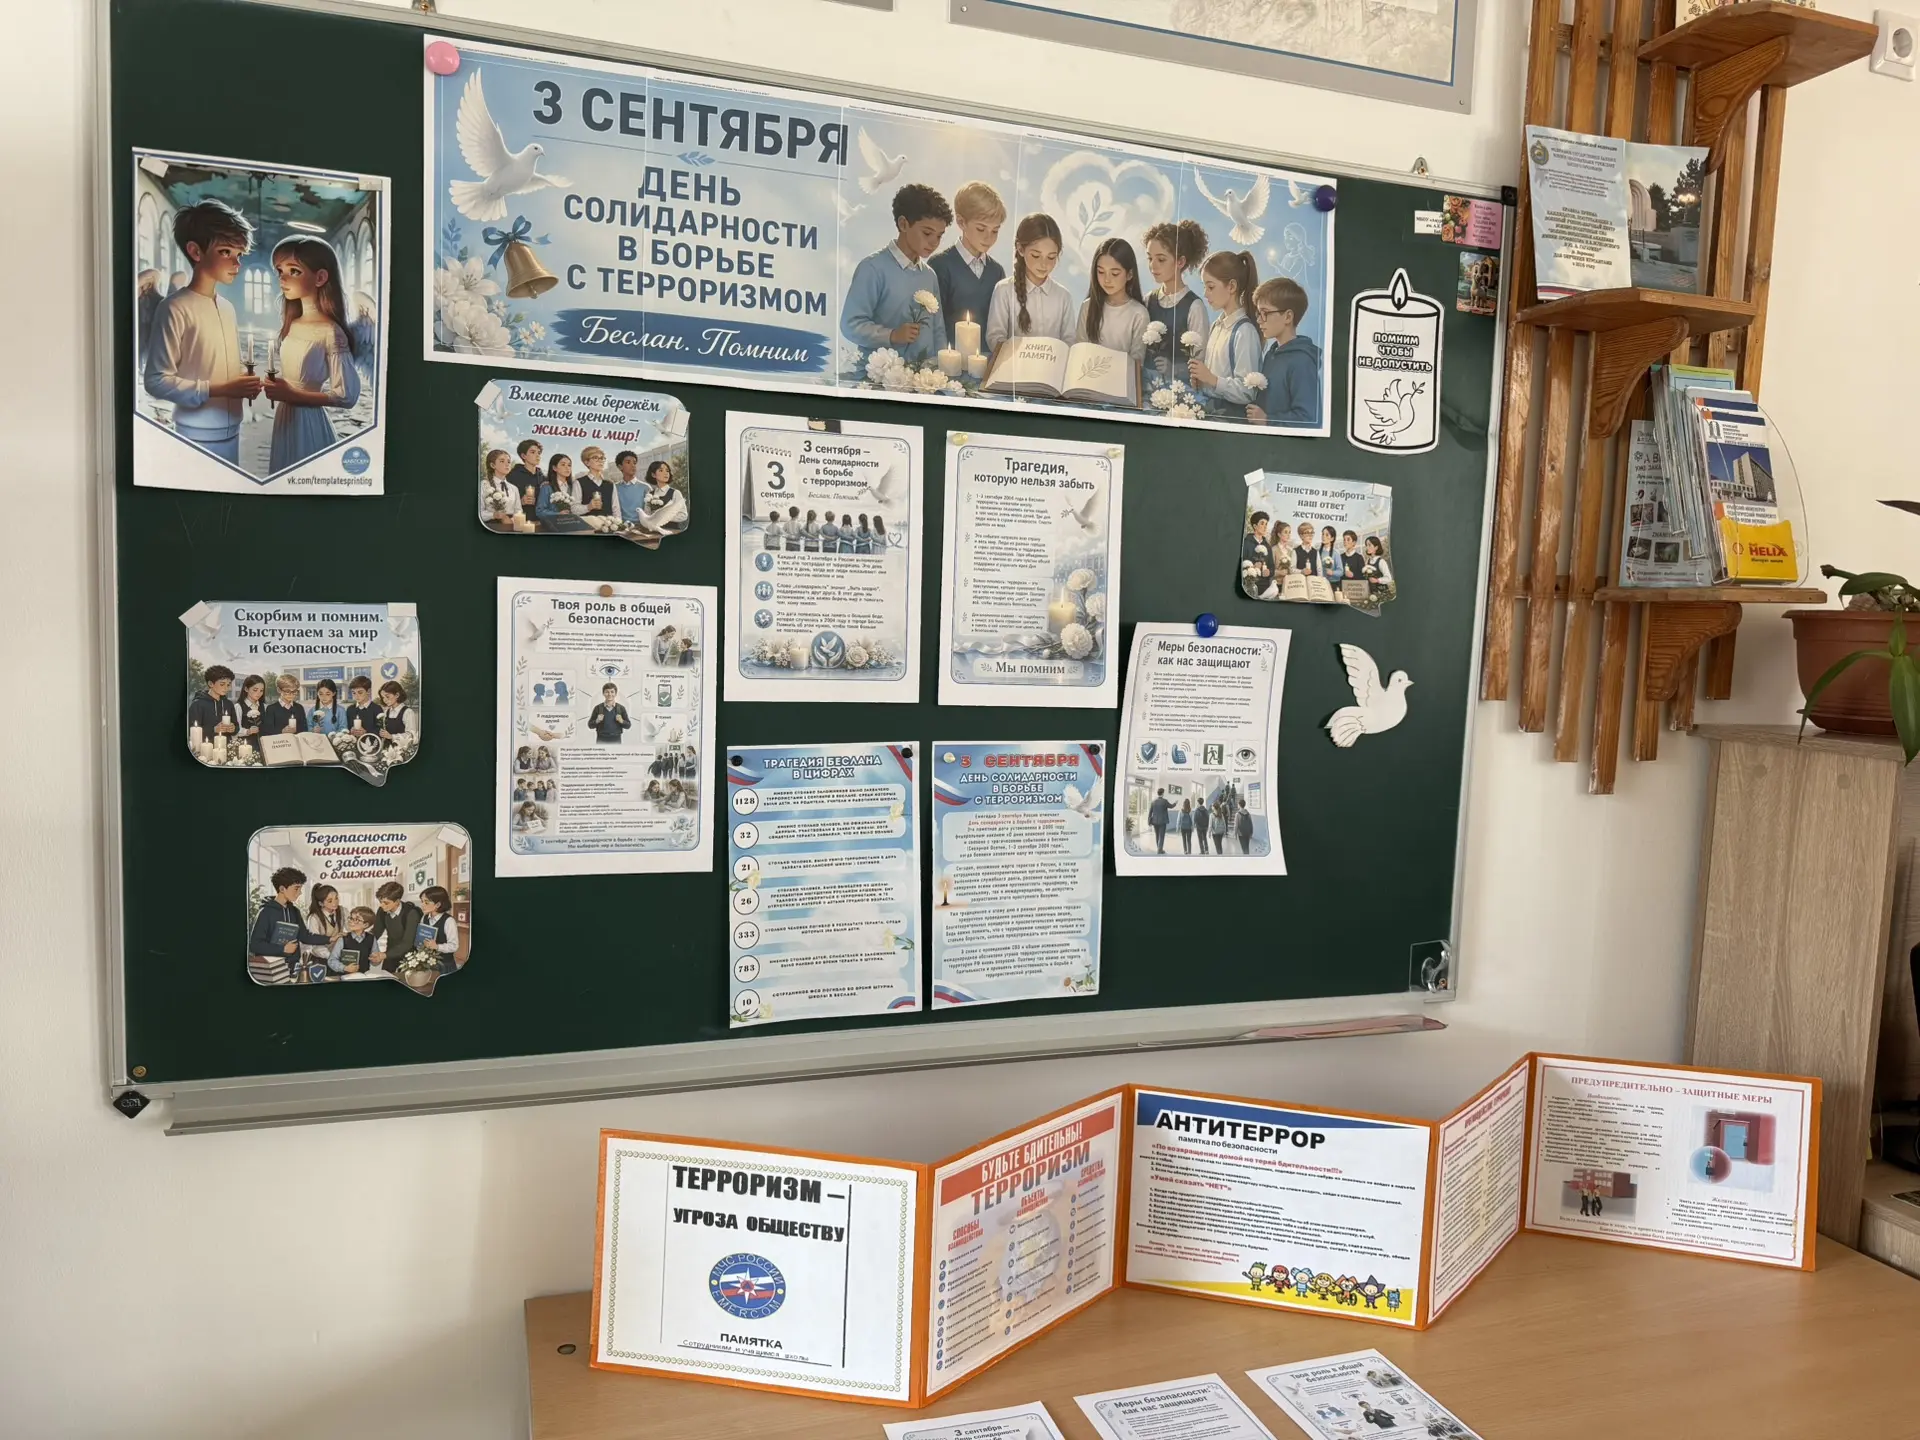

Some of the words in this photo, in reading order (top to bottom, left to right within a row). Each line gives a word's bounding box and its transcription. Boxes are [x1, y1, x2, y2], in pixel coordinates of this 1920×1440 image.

[533, 79, 563, 126] 3
[582, 87, 849, 168] СЕНТЯБРЯ
[637, 165, 741, 207] ДЕНЬ
[564, 193, 820, 252] СОЛИДАРНОСТИ
[619, 235, 637, 262] В
[651, 239, 775, 280] БОРЬБЕ
[567, 263, 587, 290] С
[596, 266, 828, 317] ТЕРРОРИЗМОМ
[579, 315, 690, 351] Беслан.
[698, 328, 810, 363] Помним
[1373, 333, 1419, 346] ПОМНИМ
[1025, 343, 1053, 353] КНИГА
[1378, 345, 1414, 358] ЧТОБЫ
[1019, 351, 1057, 362] ПАМЯТИ
[1358, 356, 1373, 368] НЕ
[1373, 358, 1433, 371] ДОПУСТИТЬ
[508, 385, 570, 405] Вместе
[573, 395, 599, 407] мы
[601, 394, 661, 413] бережём
[528, 407, 573, 422] самое
[577, 411, 626, 427] ценное
[531, 422, 587, 440] жизнь
[592, 427, 607, 438] и
[604, 430, 640, 446] мир!
[804, 441, 812, 453] 3
[815, 446, 861, 460] сентября
[799, 455, 820, 465] День
[822, 458, 879, 470] солидарности
[1004, 457, 1069, 477] Трагедия,
[767, 461, 786, 490] 3
[823, 466, 853, 478] борьбе
[287, 476, 373, 486] vk.com/templatesprinting
[810, 478, 867, 489] терроризмом
[974, 474, 1018, 487] которую
[1020, 478, 1056, 488] нельзя
[1059, 479, 1095, 490] забыть
[760, 491, 795, 500] сентября
[1276, 483, 1320, 497] Единство
[1322, 488, 1328, 496] и
[1329, 490, 1365, 501] доброта
[1297, 499, 1317, 508] наш
[1320, 501, 1345, 511] ответ
[1293, 509, 1348, 522] жестокости!
[1750, 546, 1789, 557] HELIX
[551, 599, 580, 611] Твоя
[586, 602, 615, 614] роль
[620, 603, 627, 612] в
[630, 602, 672, 615] общей
[234, 608, 302, 625] Скорбим
[307, 614, 317, 622] и
[322, 612, 384, 623] помним.
[568, 613, 655, 627] безопасности
[238, 625, 323, 642] Выступаем
[328, 628, 343, 638] за
[349, 629, 378, 642] мир
[249, 645, 258, 654] и
[263, 640, 367, 655] безопасность!
[1158, 641, 1185, 654] Меры
[1188, 641, 1262, 656] безопасности:
[996, 662, 1016, 673] Мы
[1020, 664, 1065, 675] помним
[1158, 655, 1174, 666] как
[1177, 657, 1194, 666] нас
[1196, 658, 1251, 669] защищают
[763, 756, 823, 769] ТРАГЕДИЯ
[827, 755, 882, 768] БЕСЛАНА
[959, 755, 972, 768] 3
[985, 753, 1080, 768] СЕНТЯБРЯ
[792, 769, 801, 780] В
[804, 767, 855, 779] ЦИФРАХ
[959, 773, 988, 784] ДЕНЬ
[991, 771, 1077, 784] СОЛИДАРНОСТИ
[992, 785, 1000, 794] В
[1002, 783, 1043, 794] БОРЬБЕ
[735, 797, 756, 806] 1128
[974, 795, 982, 805] С
[985, 794, 1063, 806] ТЕРРОРИЗМОМ
[305, 832, 407, 846] Безопасность
[740, 832, 752, 840] 32
[312, 845, 406, 857] начинается
[325, 860, 332, 868] с
[336, 856, 391, 871] заботы
[741, 863, 751, 871] 21
[319, 872, 327, 880] о
[330, 867, 399, 880] ближнем!
[741, 898, 752, 906] 26
[738, 930, 755, 939] 333
[738, 962, 755, 972] 783
[742, 998, 752, 1007] 10
[1571, 1076, 1673, 1094] ПРЕДУПРЕДИТЕЛЬНО
[1681, 1086, 1740, 1102] ЗАЩИТНЫЕ
[1741, 1093, 1772, 1105] МЕРЫ
[1156, 1111, 1326, 1150] АНТИТЕРРОР
[981, 1147, 1021, 1184] БУДЬТЕ
[1023, 1121, 1083, 1165] БДИТЕЛЬНЫ!
[1178, 1135, 1211, 1148] памятка
[1211, 1140, 1221, 1148] по
[1221, 1139, 1278, 1155] безопасности
[1219, 1153, 1243, 1163] домой
[672, 1165, 821, 1203] ТЕРРОРИЗМ
[971, 1140, 1091, 1216] ТЕРРОРИЗМ
[1175, 1176, 1204, 1188] сказать
[673, 1208, 738, 1230] УГРОЗА
[746, 1215, 844, 1243] ОБЩЕСТВУ
[713, 1254, 736, 1278] МЧС
[737, 1253, 784, 1285] РОССИИ
[711, 1290, 782, 1319] EMERCOM
[720, 1332, 783, 1350] ПАМЯТКА
[1289, 1371, 1310, 1380] Твоя
[1312, 1368, 1329, 1378] роль
[1338, 1362, 1364, 1374] общей
[1305, 1369, 1361, 1383] безопасности
[1114, 1396, 1143, 1409] Меры
[1143, 1386, 1211, 1404] безопасности:
[1121, 1407, 1139, 1415] как
[1140, 1404, 1157, 1412] нас
[1158, 1395, 1208, 1411] защищают
[954, 1429, 963, 1437] 3
[965, 1425, 1003, 1437] сентября
[973, 1427, 1020, 1440] солидарности
